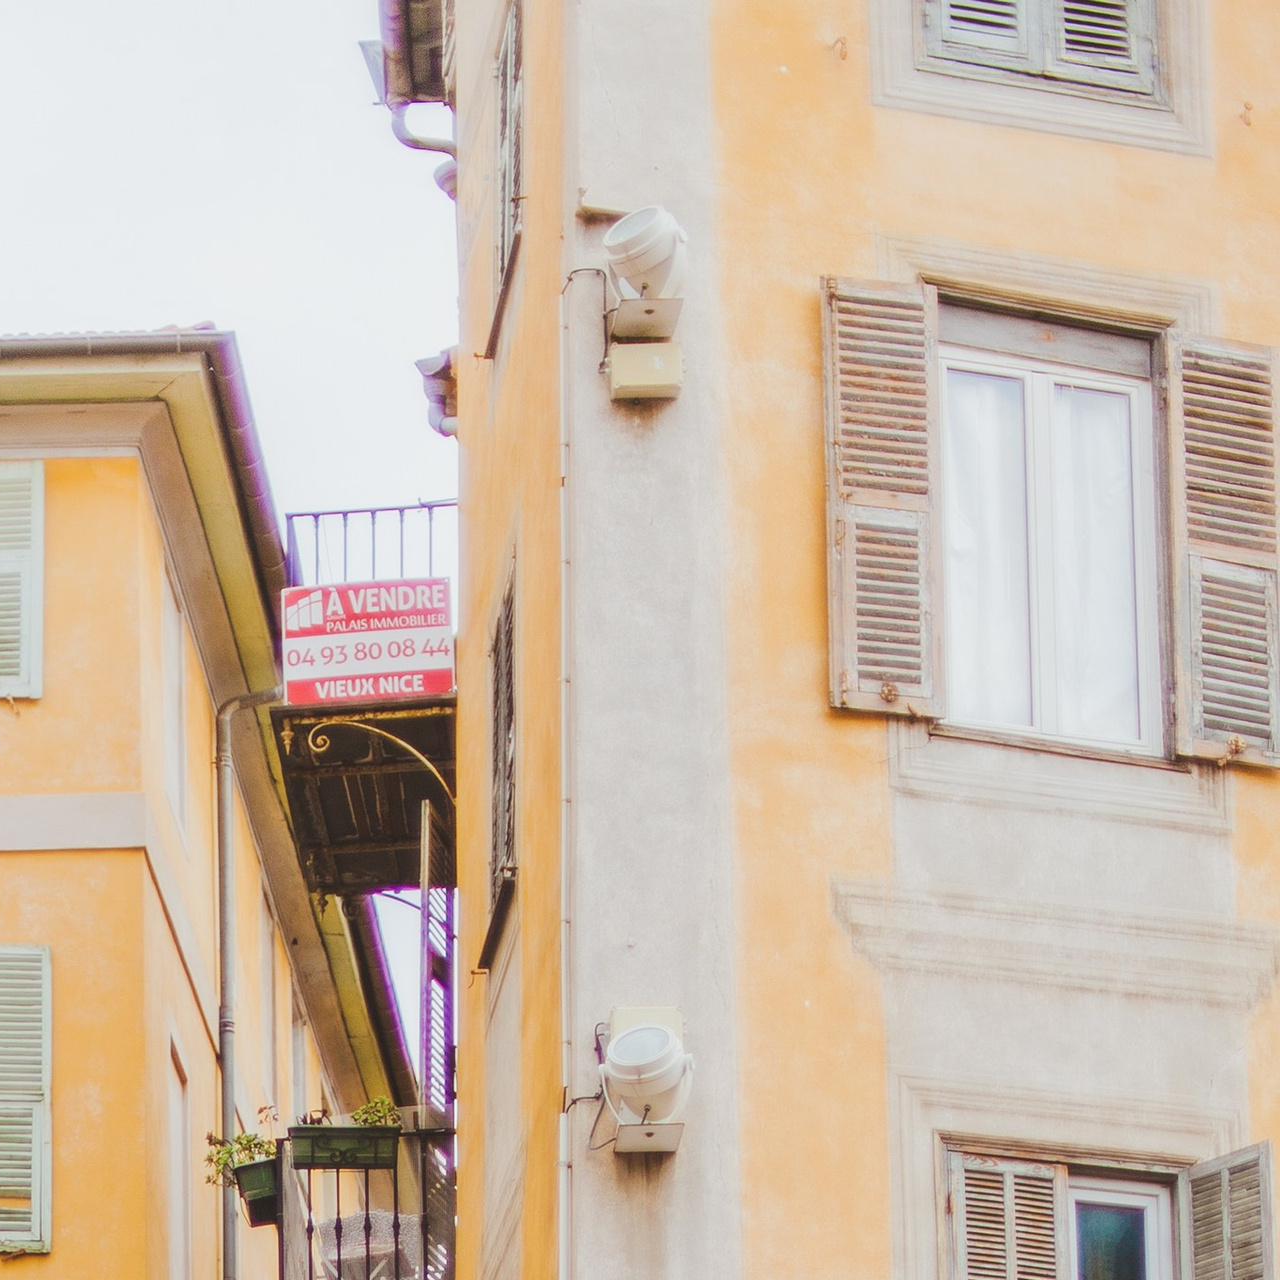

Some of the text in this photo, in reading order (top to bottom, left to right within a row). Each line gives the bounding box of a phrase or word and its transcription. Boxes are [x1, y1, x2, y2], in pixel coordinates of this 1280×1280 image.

[326, 584, 446, 615] À VENDRE
[326, 613, 447, 632] PALAIS IMMOBILIER
[286, 637, 450, 667] 04 93 80 08 44
[315, 674, 424, 699] VIEUX NICE
